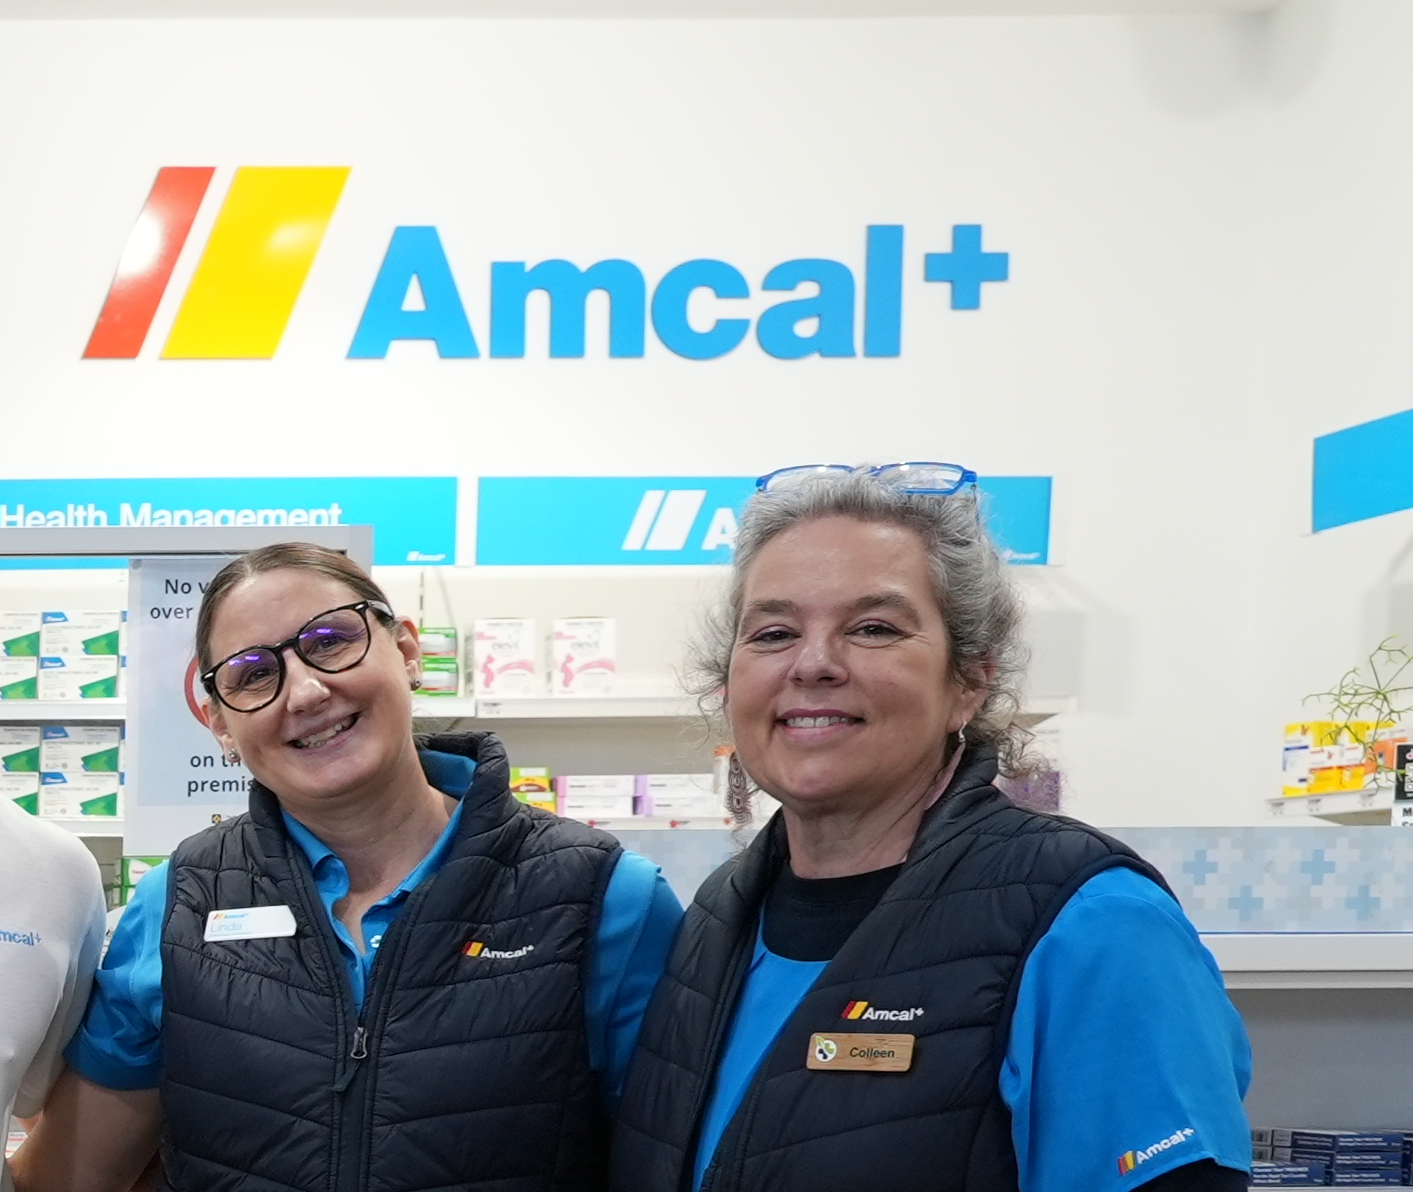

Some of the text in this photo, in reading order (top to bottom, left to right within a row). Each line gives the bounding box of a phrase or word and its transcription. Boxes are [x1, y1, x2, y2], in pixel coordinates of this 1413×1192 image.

[119, 501, 343, 526] Management
[165, 578, 192, 595] No
[150, 606, 194, 620] over
[190, 755, 215, 768] on
[187, 775, 254, 798] premis
[862, 1005, 925, 1022] Amcal+
[849, 1046, 895, 1060] Colleen
